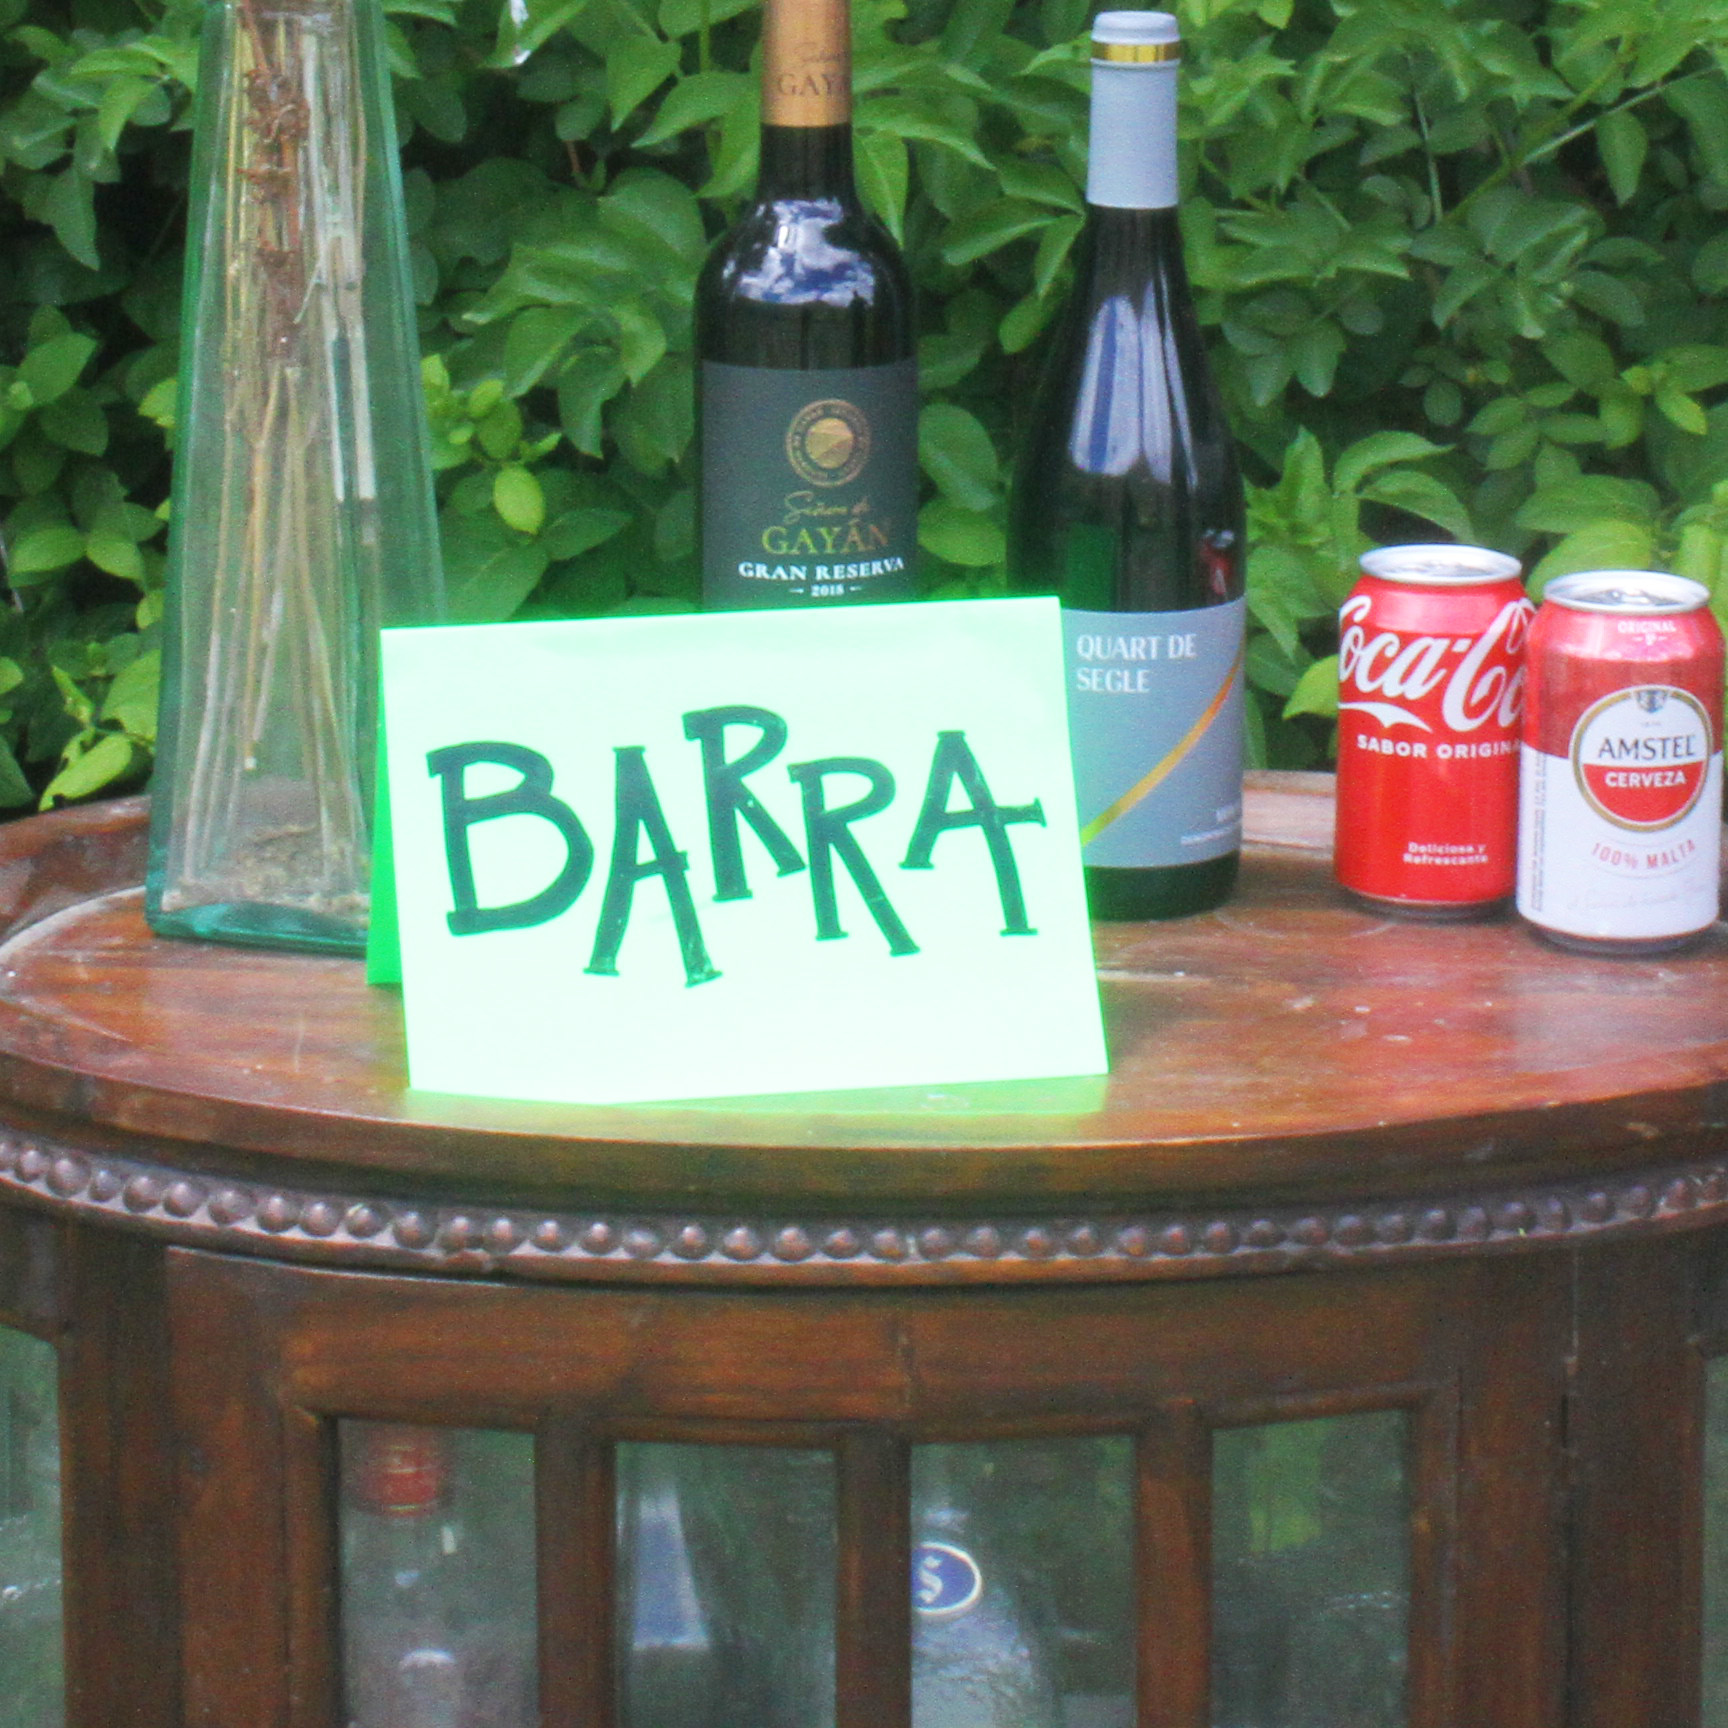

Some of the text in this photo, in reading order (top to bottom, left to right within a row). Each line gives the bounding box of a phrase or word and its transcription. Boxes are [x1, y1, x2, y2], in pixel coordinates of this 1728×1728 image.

[738, 556, 905, 581] GRAN RESERVA
[1076, 633, 1198, 661] QUART DE
[1076, 667, 1151, 694] SEGLE
[1357, 734, 1522, 761] SABOR ORIGIN
[1598, 734, 1696, 761] AMSTEL
[1604, 769, 1687, 788] CERVEZA
[426, 705, 1047, 989] BARRA
[1592, 838, 1697, 870] 100% MALTA
